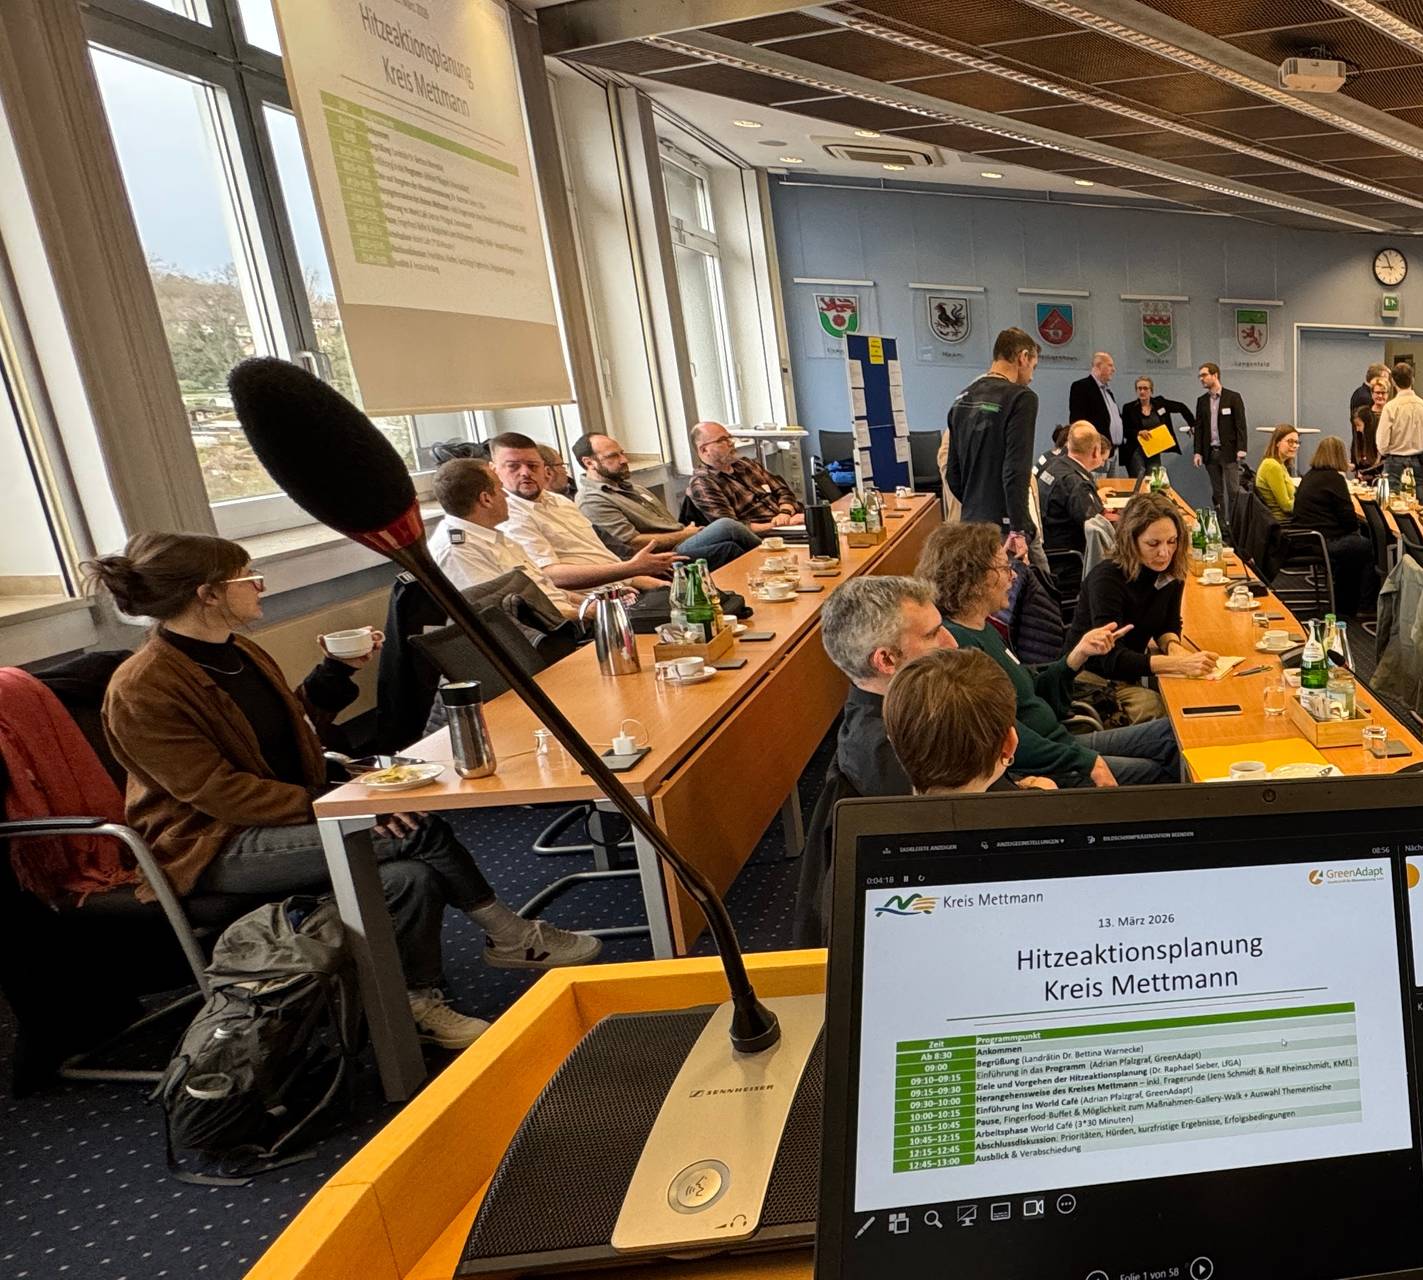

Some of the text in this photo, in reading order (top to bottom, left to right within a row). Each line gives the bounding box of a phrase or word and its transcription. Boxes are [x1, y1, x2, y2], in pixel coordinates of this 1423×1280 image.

[359, 3, 474, 90] Hitzeaktionsplanung
[382, 56, 470, 119] Kreis Mettmann
[1326, 867, 1384, 879] GreenAdapt
[944, 892, 1044, 908] Kreis Mettmann
[1098, 914, 1175, 928] 13. März 2026
[1017, 936, 1263, 972] Hitzeaktionsplanung
[1045, 970, 1238, 1000] Kreis Mettmann
[928, 1040, 944, 1048] Zeit
[976, 1032, 1040, 1045] Programmpunkt
[921, 1052, 952, 1061] Ab 8:30
[976, 1046, 1022, 1055] Ankommen
[977, 1058, 1020, 1068] Begrüßung
[1022, 1053, 1060, 1064] (Landrätin
[1075, 1050, 1102, 1058] Bettina
[1104, 1045, 1144, 1055] Warnecke)
[924, 1063, 948, 1072] 09:00
[977, 1070, 1019, 1079] Einführung
[1030, 1066, 1043, 1074] das
[1046, 1064, 1086, 1073] Programm
[1090, 1060, 1117, 1070] (Adrian
[1155, 1051, 1202, 1062] GreenAdapt)
[977, 1083, 995, 1091] Ziele
[997, 1081, 1012, 1089] und
[1014, 1078, 1052, 1087] Vorgehen
[1054, 1076, 1067, 1084] der
[1070, 1069, 1147, 1082] Hitzeaktionsplanung
[1164, 1063, 1194, 1073] Raphael
[1196, 1061, 1220, 1070] Sieber,
[706, 1084, 774, 1096] SENNHEISER
[977, 1090, 1050, 1102] Herangehensweise
[1068, 1085, 1095, 1093] Kreises
[1098, 1081, 1138, 1090] Mettmann
[1164, 1074, 1206, 1084] Fragerunde
[1208, 1073, 1225, 1081] (Jens
[1227, 1069, 1256, 1078] Schmidt
[1266, 1066, 1280, 1074] Rolf
[1282, 1062, 1331, 1072] Rheinschmidt,
[977, 1105, 1020, 1114] Einführung
[1035, 1100, 1059, 1108] World
[1081, 1095, 1108, 1105] (Adrian
[1146, 1086, 1193, 1096] GreenAdapt)
[1082, 1104, 1126, 1116] Möglichkeit
[1250, 1088, 1280, 1098] Auswahl
[1282, 1084, 1332, 1095] Thementische
[976, 1127, 1028, 1138] Arbeitsphase
[1031, 1123, 1054, 1132] World
[1099, 1115, 1134, 1125] Minuten)
[1106, 1128, 1136, 1136] Hürden,
[1138, 1123, 1179, 1133] kurzfristige
[1224, 1111, 1296, 1124] Erfolgsbedingungen
[976, 1152, 1009, 1162] Ausblick
[1020, 1145, 1081, 1157] Verabschiedung
[1143, 1272, 1147, 1280] 1
[1150, 1270, 1166, 1279] von
[1169, 1268, 1179, 1277] 58
